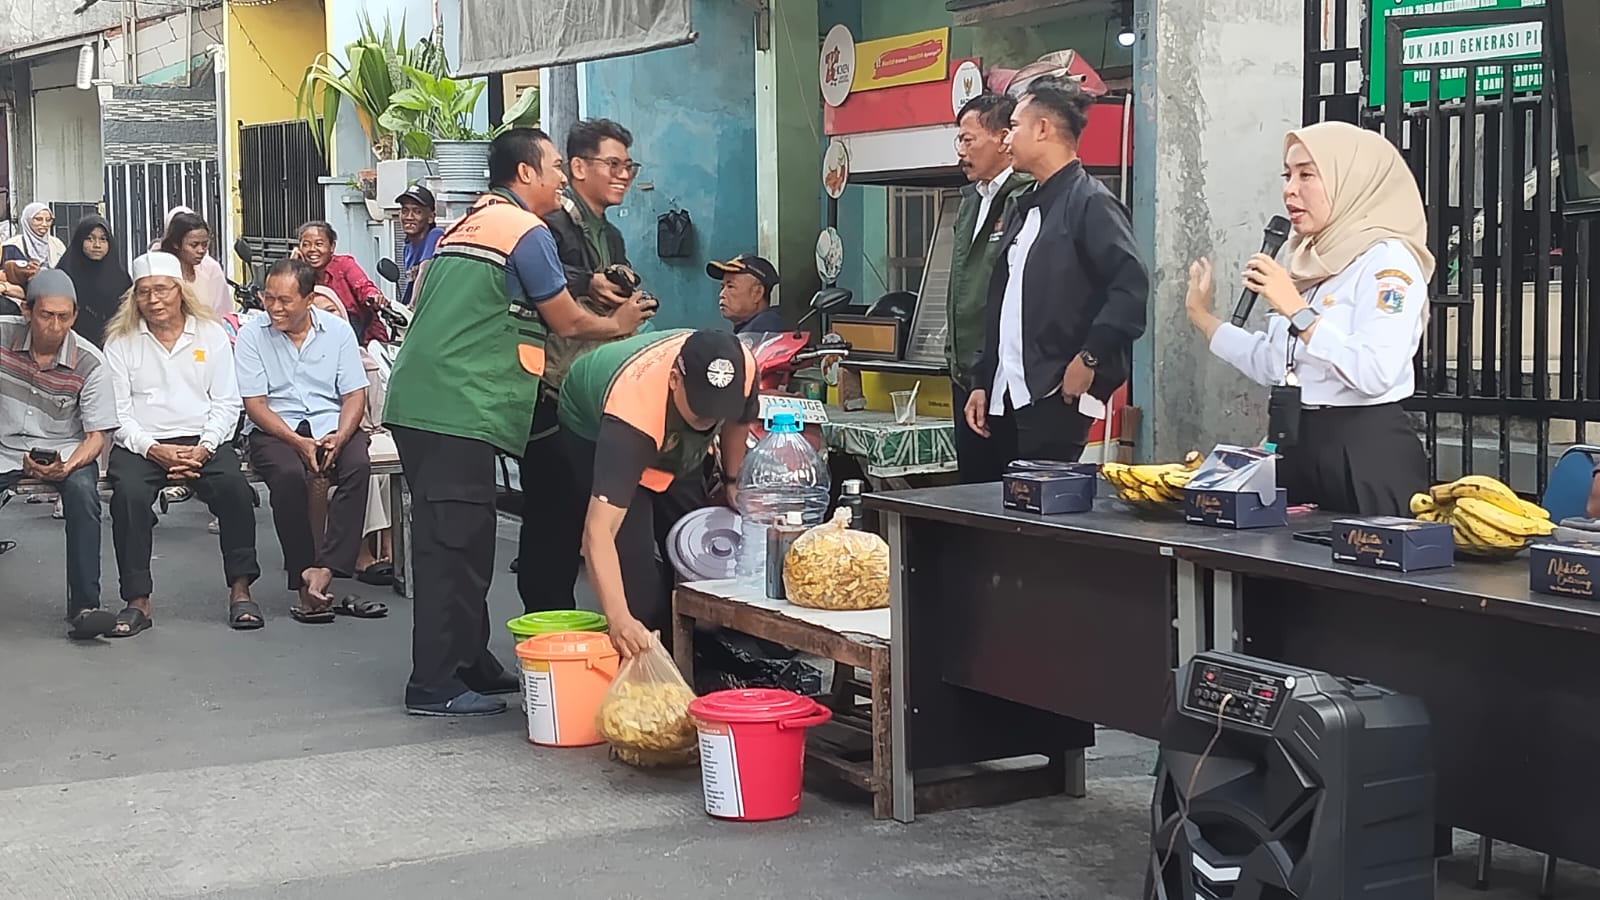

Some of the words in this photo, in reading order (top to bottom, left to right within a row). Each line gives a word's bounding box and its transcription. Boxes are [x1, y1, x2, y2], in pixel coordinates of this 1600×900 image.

[1428, 40, 1454, 57] JADI
[1460, 32, 1520, 54] GENERASI
[1525, 29, 1538, 46] PI
[1439, 67, 1467, 80] SAMP
